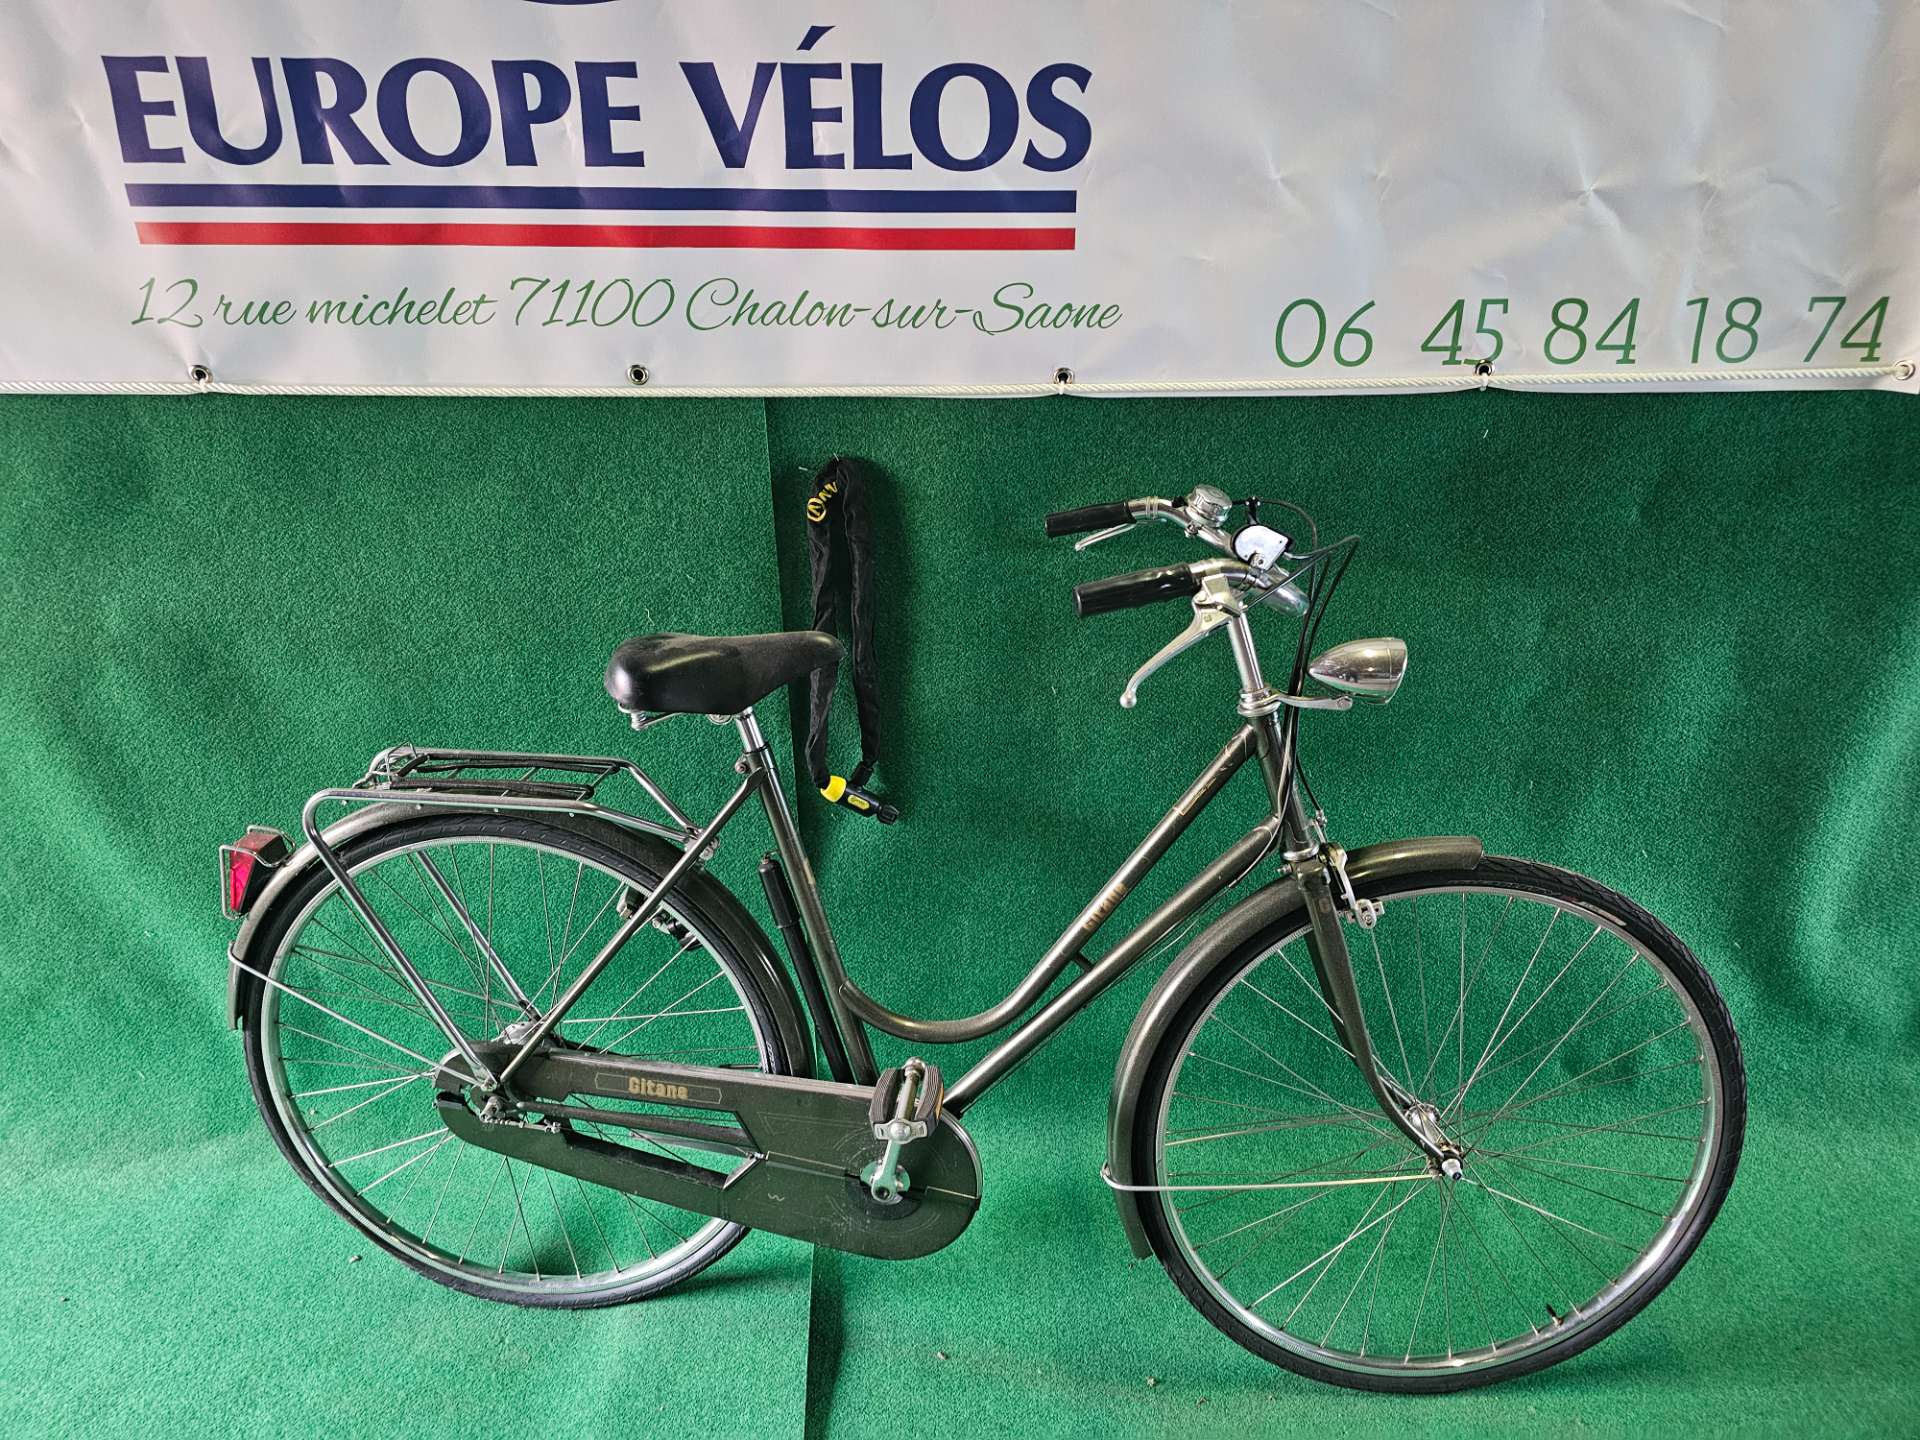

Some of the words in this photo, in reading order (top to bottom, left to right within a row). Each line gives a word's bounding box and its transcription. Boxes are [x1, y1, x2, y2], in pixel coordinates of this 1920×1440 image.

[102, 55, 645, 168] EUROPE
[680, 25, 1093, 172] VÉLOS
[131, 276, 203, 328] 12
[213, 293, 297, 326] rue
[305, 286, 498, 326] michelet
[510, 277, 676, 328] 71100
[685, 277, 1122, 336] Chalon-sur-Saone
[1275, 298, 1376, 368] 06
[1421, 298, 1509, 368] 45
[1543, 297, 1640, 365] 84
[1686, 296, 1762, 364] 18
[1803, 296, 1890, 362] 74
